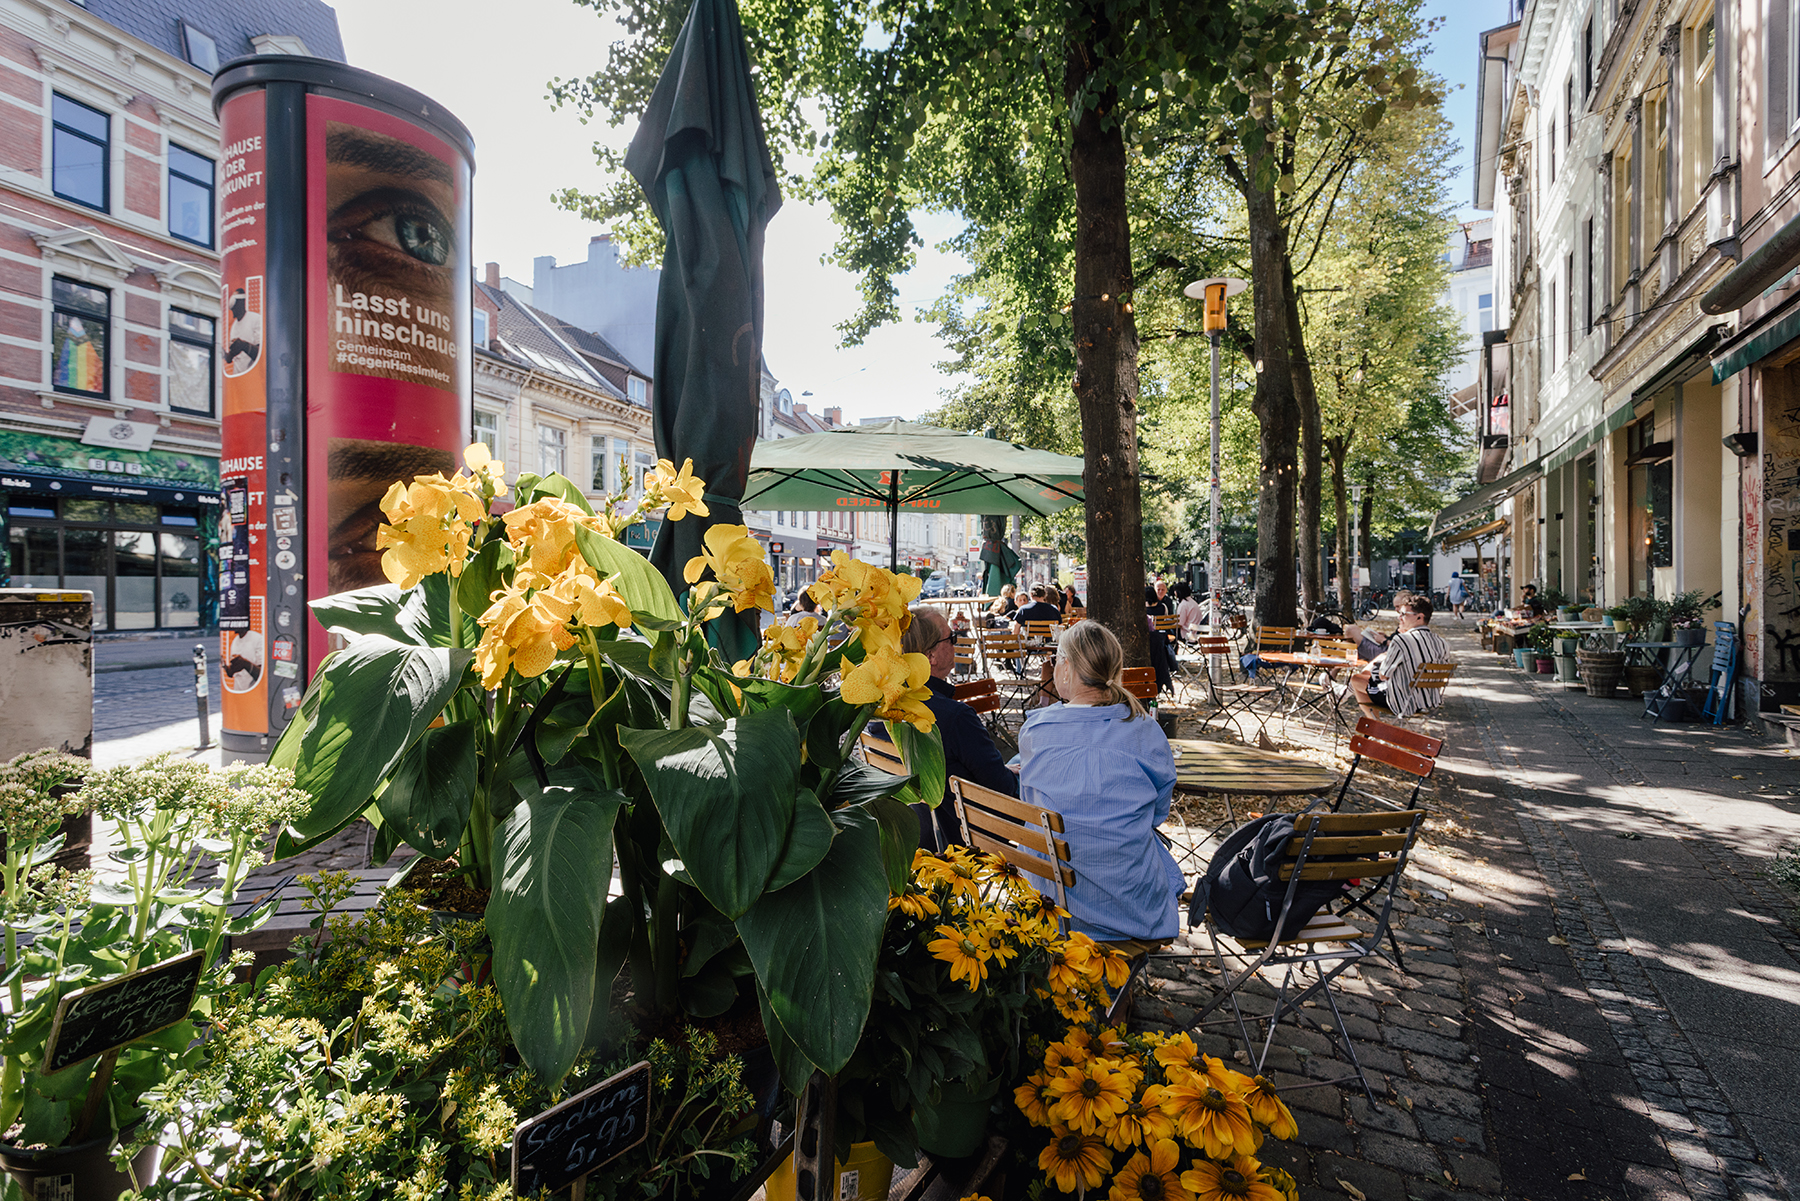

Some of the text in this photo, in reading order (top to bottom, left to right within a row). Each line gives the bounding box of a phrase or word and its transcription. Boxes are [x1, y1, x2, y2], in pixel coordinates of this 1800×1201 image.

[226, 158, 246, 178] DER
[336, 284, 451, 332] Lasst uns
[336, 340, 411, 360] Gemeinsam
[336, 352, 450, 383] #GegenHassImNetz
[522, 1084, 638, 1161] Sedum
[564, 1095, 645, 1172] 5,95
